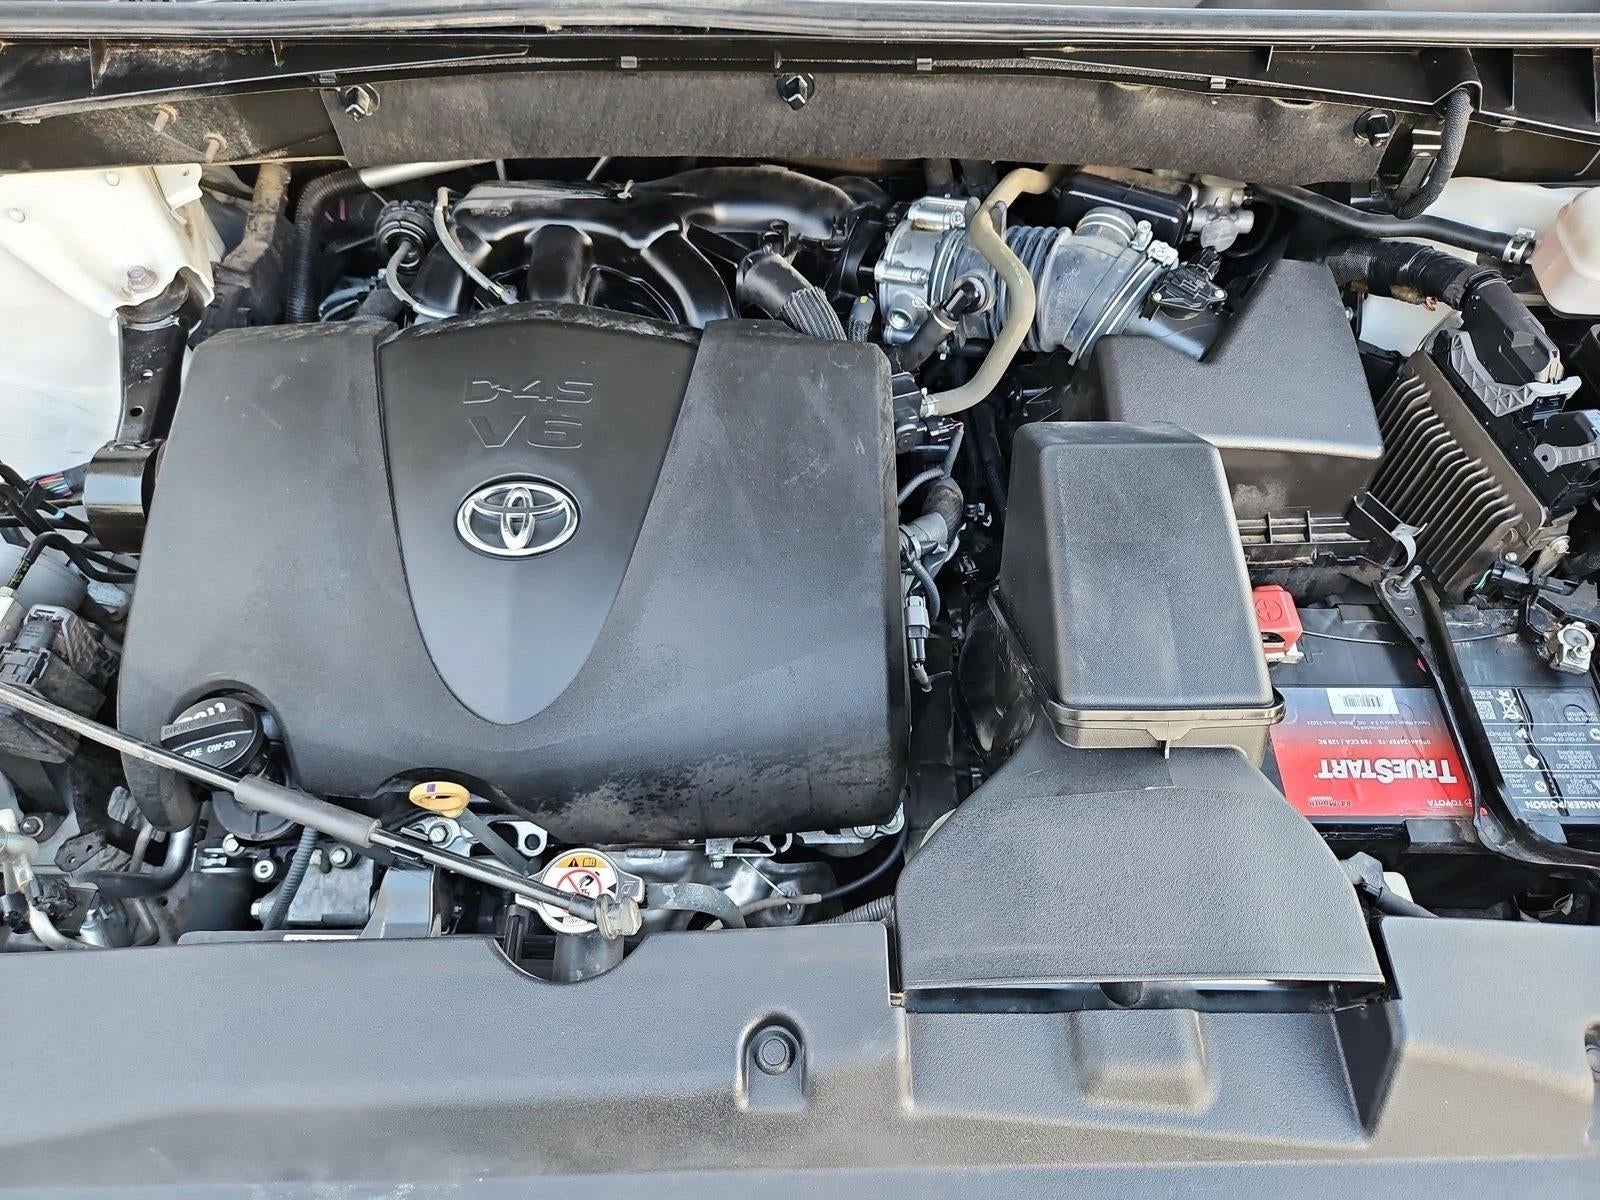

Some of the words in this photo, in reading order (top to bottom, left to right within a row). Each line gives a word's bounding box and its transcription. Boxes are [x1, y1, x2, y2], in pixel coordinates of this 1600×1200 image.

[467, 413, 584, 450] V6
[184, 747, 203, 758] SAE
[207, 740, 236, 754] 0W-20
[1524, 800, 1600, 810] ANGER/POISON
